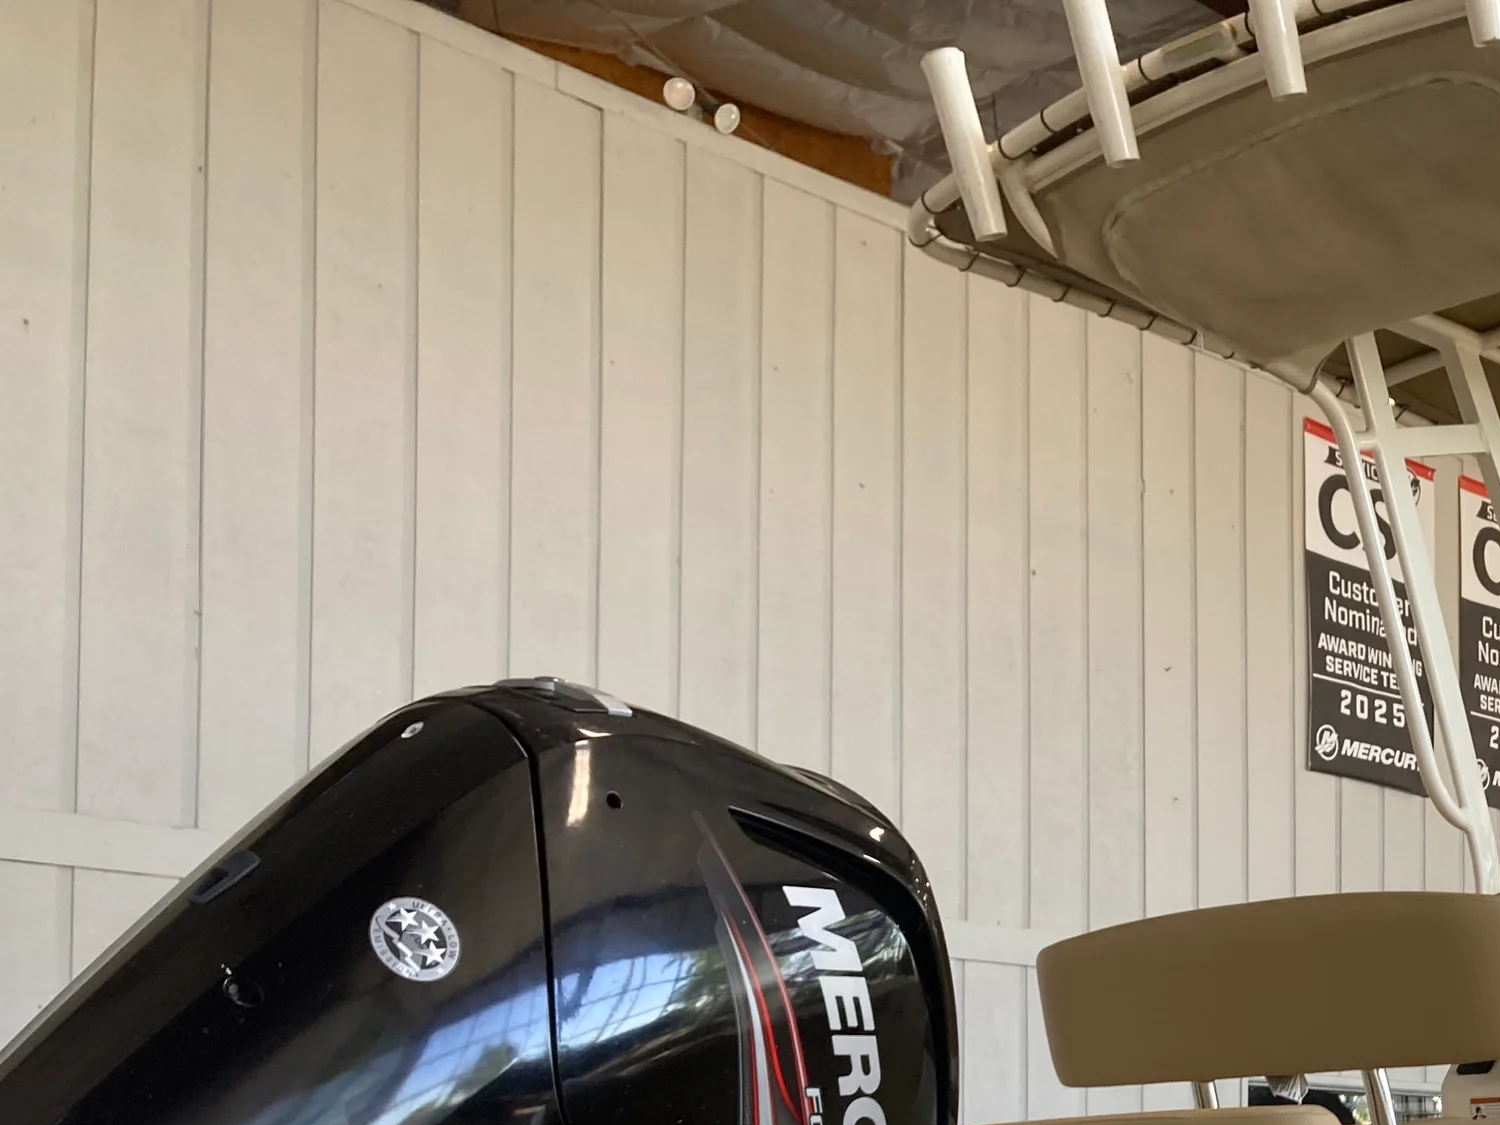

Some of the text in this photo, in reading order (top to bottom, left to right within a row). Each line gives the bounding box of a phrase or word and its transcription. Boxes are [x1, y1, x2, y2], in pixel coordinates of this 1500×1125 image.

[1329, 571, 1411, 617] Custoer
[1324, 596, 1418, 646] Nominad
[1318, 632, 1366, 661] AWARD
[1325, 655, 1379, 686] SERVICE
[1340, 688, 1405, 728] 2025
[1341, 738, 1419, 772] MERCUR
